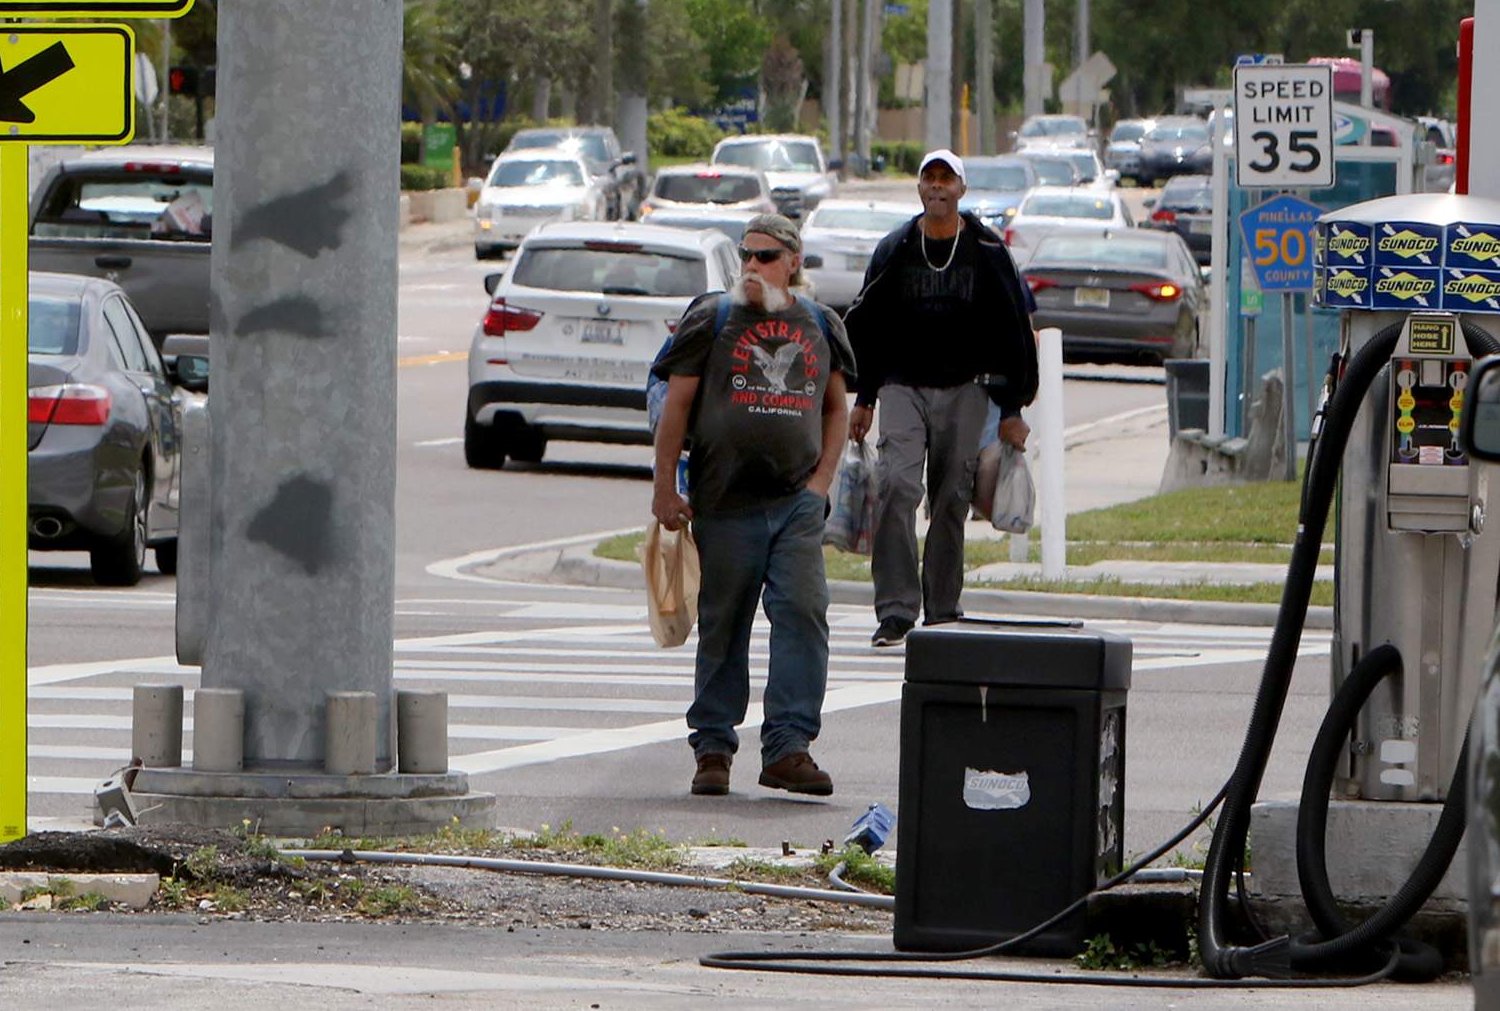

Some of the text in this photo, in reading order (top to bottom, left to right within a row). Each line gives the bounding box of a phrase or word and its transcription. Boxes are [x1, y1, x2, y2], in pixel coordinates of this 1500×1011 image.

[1243, 80, 1324, 99] SPEED
[1252, 106, 1315, 123] LIMIT
[1248, 130, 1322, 173] 35
[1258, 211, 1313, 223] PINELLAS
[1330, 238, 1368, 250] SUNOCO
[1380, 237, 1436, 251] SUNOCO
[1453, 240, 1500, 253] SUNOC
[1264, 269, 1310, 282] COUNTY
[1329, 279, 1366, 291] SUNOCO
[1378, 279, 1432, 292] SUNOCO
[731, 319, 820, 378] LEVI STRAUSS
[731, 392, 814, 410] AND COMPANY
[747, 405, 803, 417] CALIFORNIA
[971, 778, 1026, 790] SUNOCO
